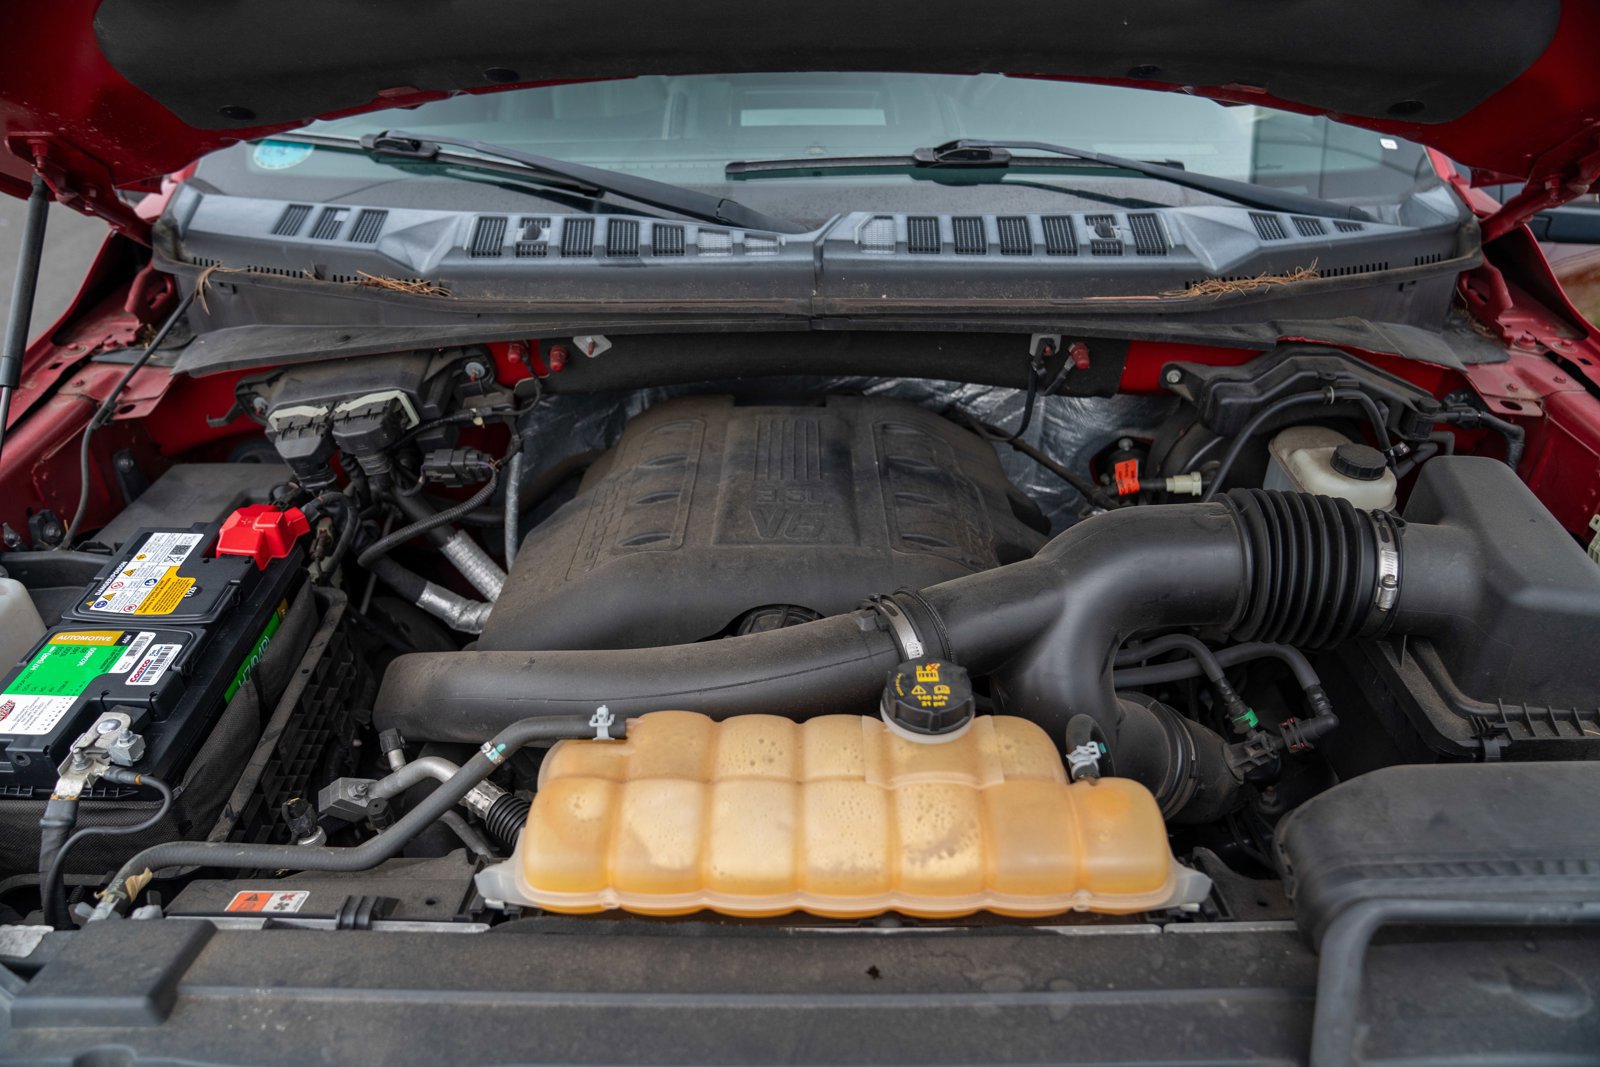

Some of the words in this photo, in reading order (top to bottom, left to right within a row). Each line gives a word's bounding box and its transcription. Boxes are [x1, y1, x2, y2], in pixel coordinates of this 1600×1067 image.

[748, 509, 825, 539] V6
[57, 634, 112, 642] AUTOMOTIVE
[129, 658, 151, 683] COSTCO
